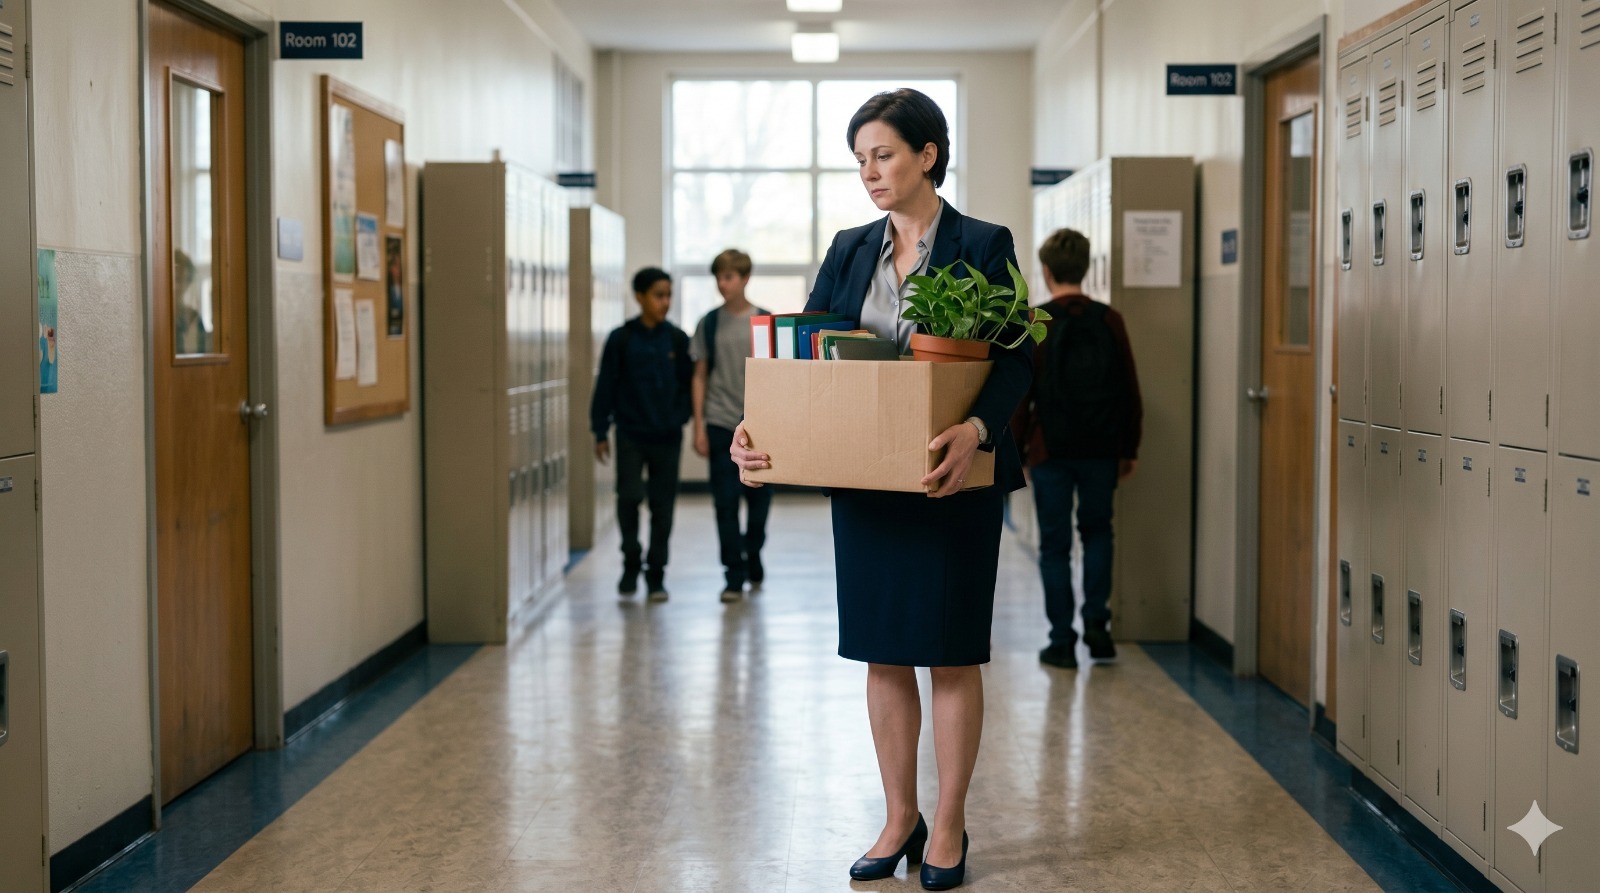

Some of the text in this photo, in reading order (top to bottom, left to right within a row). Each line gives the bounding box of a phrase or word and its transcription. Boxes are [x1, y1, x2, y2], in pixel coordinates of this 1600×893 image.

[285, 32, 357, 48] Room 102
[1170, 72, 1233, 87] Room 102
